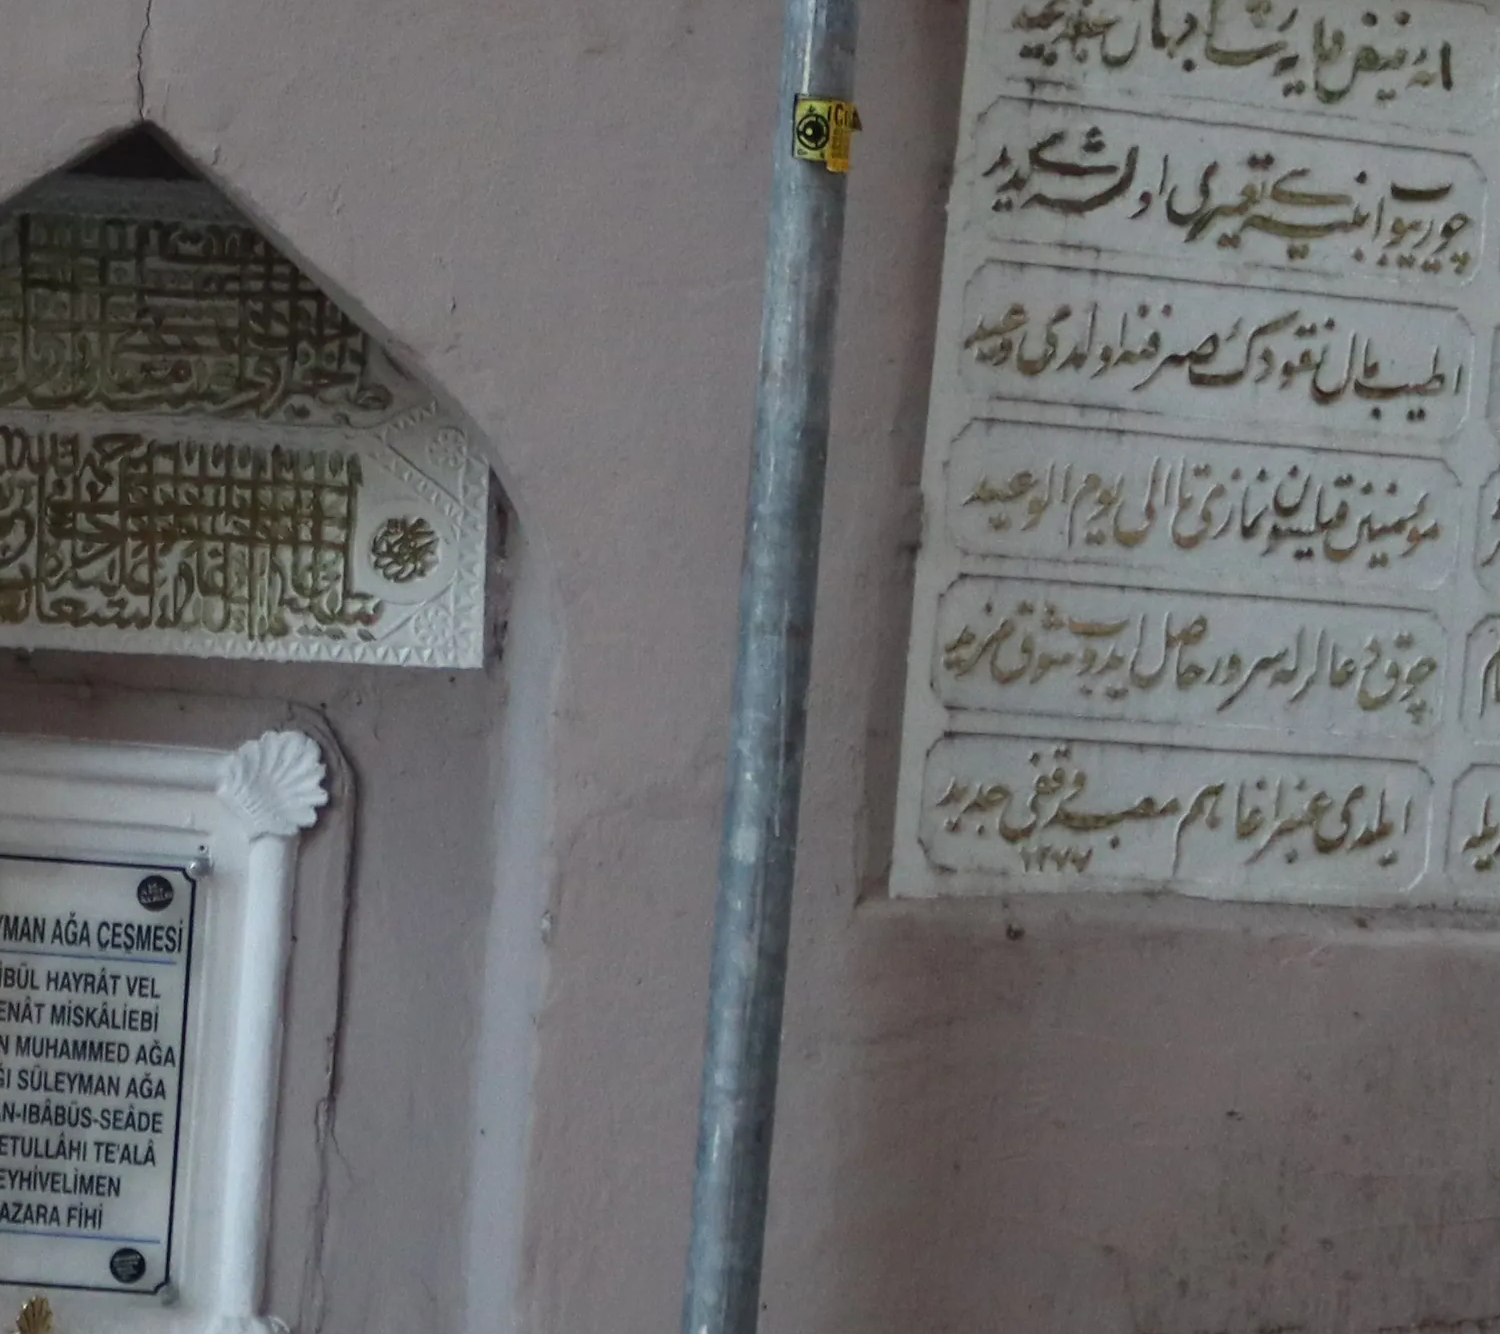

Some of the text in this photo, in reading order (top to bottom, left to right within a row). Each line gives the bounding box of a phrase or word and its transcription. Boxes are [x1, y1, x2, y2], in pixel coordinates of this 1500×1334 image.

[50, 911, 90, 947] AĞA
[96, 920, 182, 956] ÇEŞMESİ
[46, 967, 121, 995] HAYRÂT
[125, 975, 160, 999] VEL
[15, 1034, 130, 1063] MUHAMMED
[134, 1039, 174, 1066] AĞA
[17, 1065, 120, 1096] SÜLEYMAN
[125, 1072, 165, 1099] AĞA
[66, 1202, 102, 1230] FİHİ
